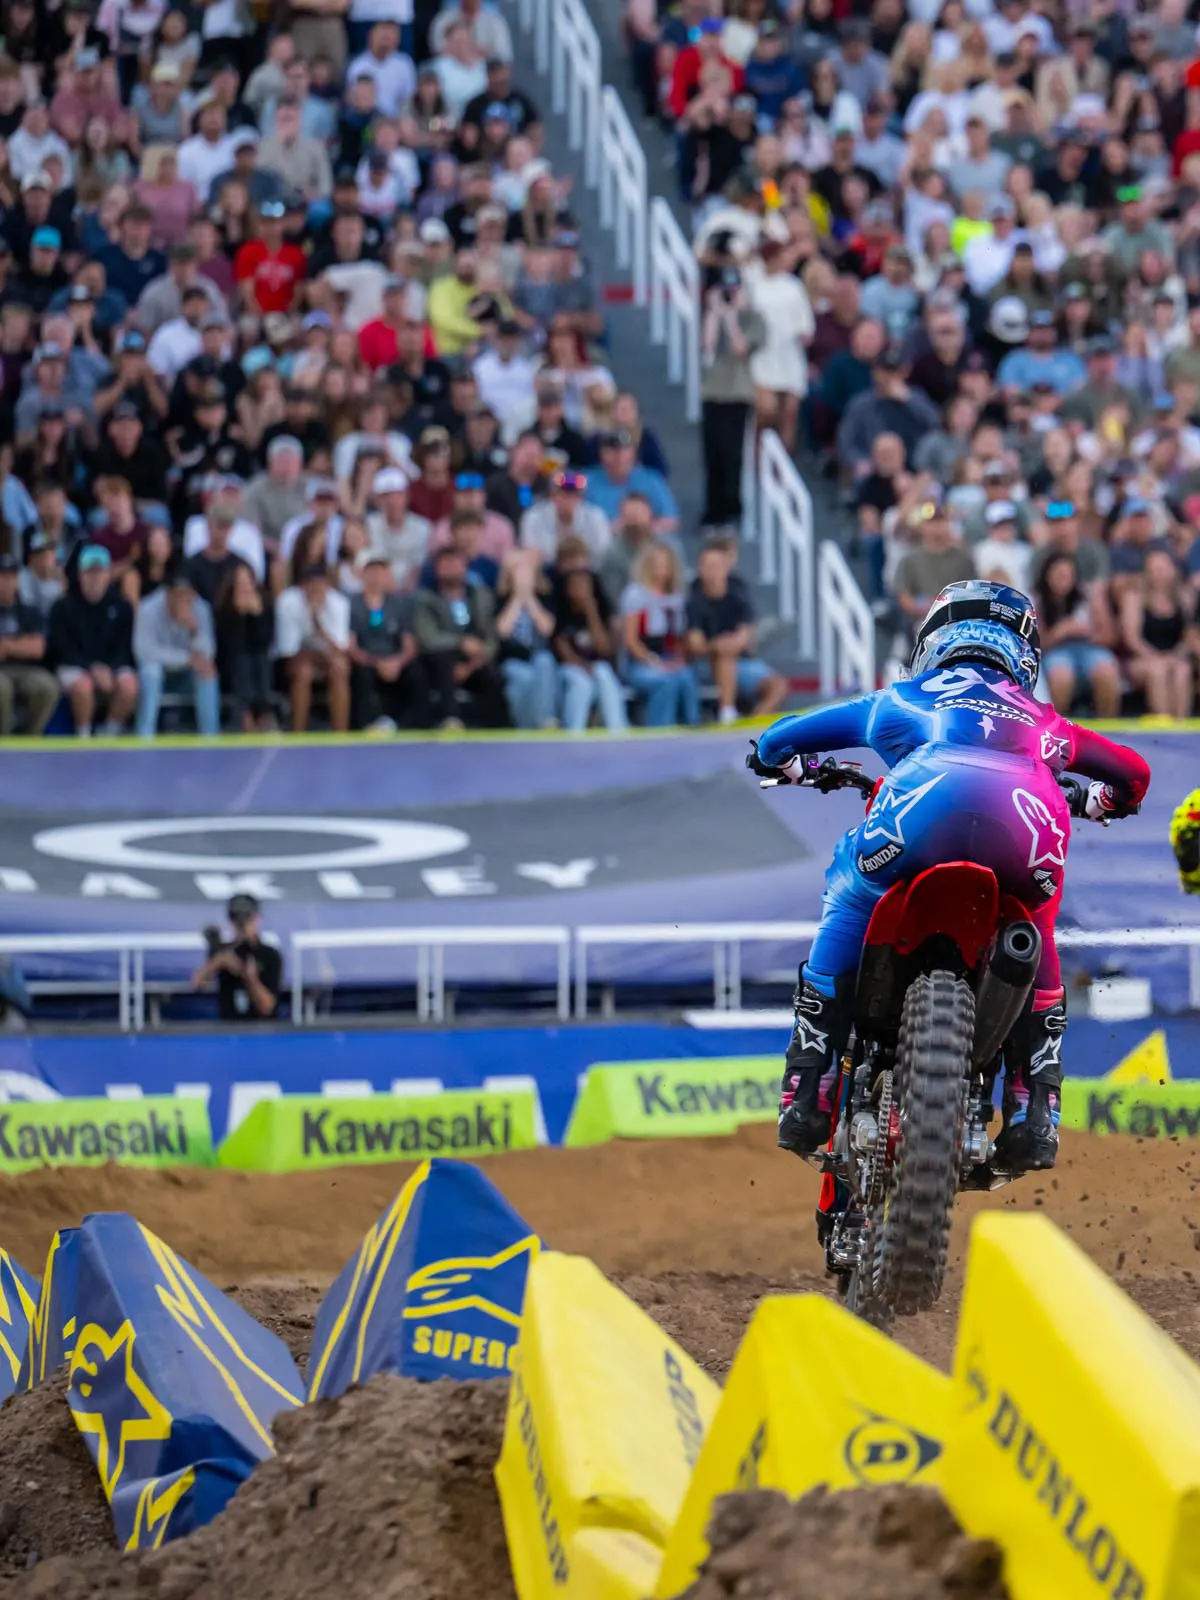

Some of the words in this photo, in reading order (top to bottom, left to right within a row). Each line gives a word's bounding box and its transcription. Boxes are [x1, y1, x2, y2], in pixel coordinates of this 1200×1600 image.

[932, 698, 1038, 726] HONDA
[863, 844, 901, 871] HONDA
[302, 1102, 512, 1156] Kawasaki
[988, 1386, 1146, 1600] DUNLOP
